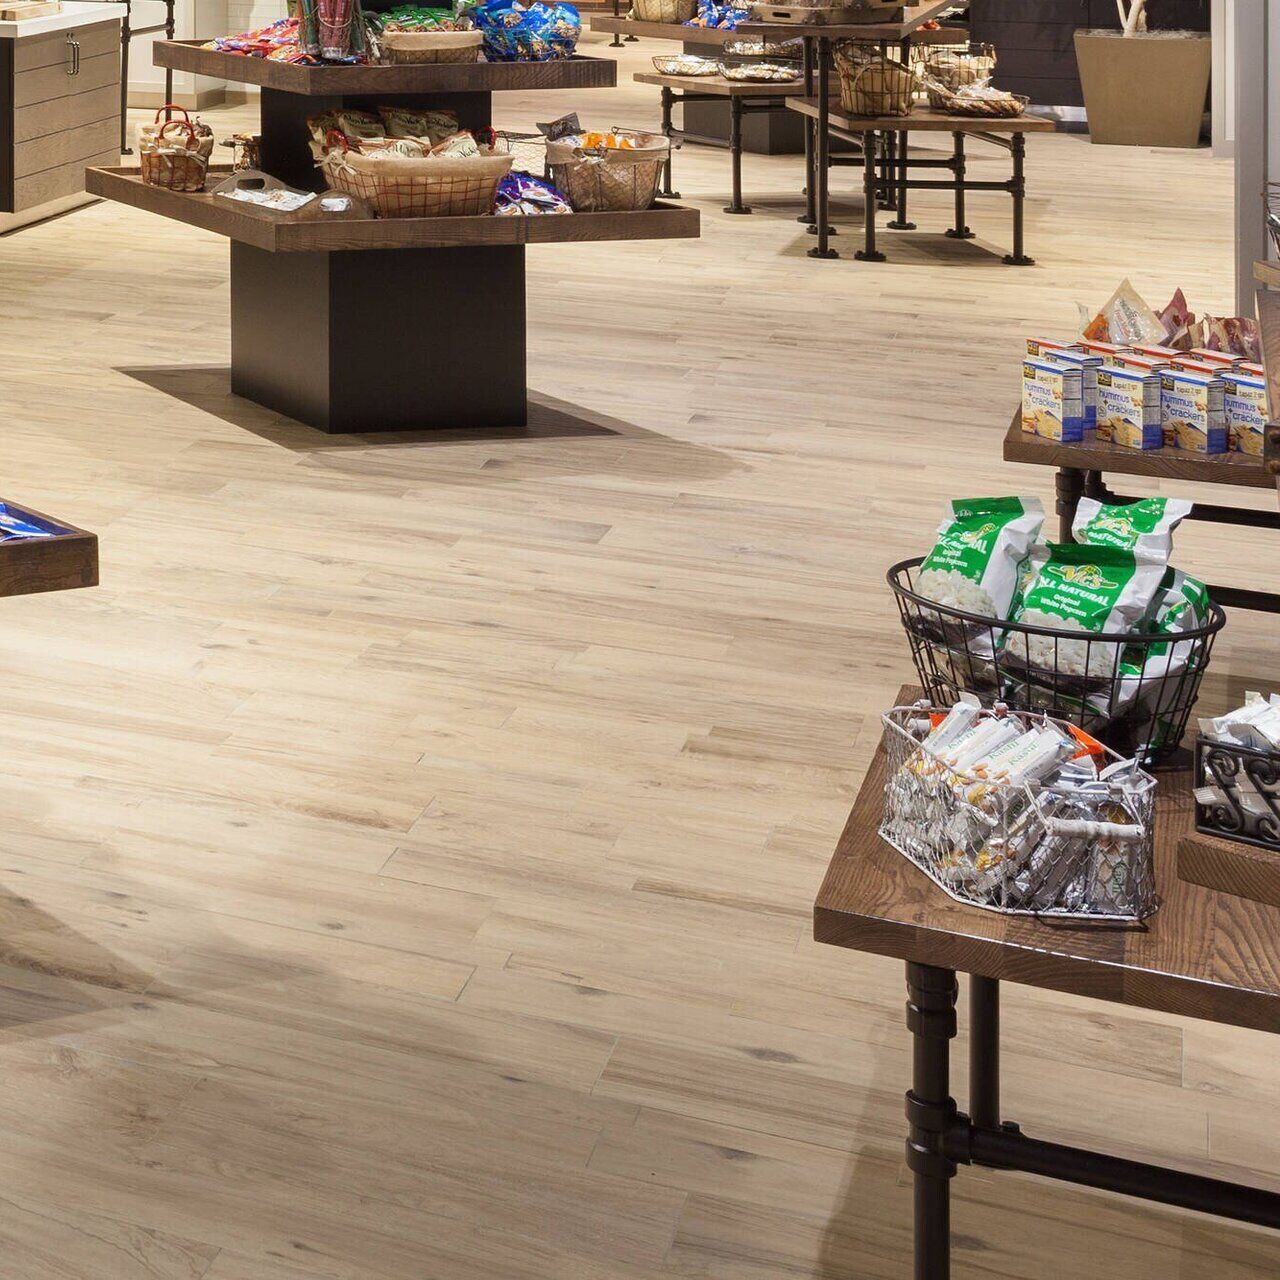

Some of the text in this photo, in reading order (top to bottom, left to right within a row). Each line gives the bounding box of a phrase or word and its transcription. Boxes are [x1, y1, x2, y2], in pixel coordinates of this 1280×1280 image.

[1024, 382, 1051, 396] hummus
[1032, 396, 1060, 409] crackers
[1099, 390, 1130, 404] hummus
[1160, 394, 1193, 408] hummus
[1108, 404, 1140, 417] crackers
[1225, 398, 1256, 412] hummus
[1170, 407, 1205, 422] crackers
[1054, 594, 1080, 607] Original
[1058, 582, 1110, 606] NATURAL
[1041, 597, 1087, 617] White Popcorn
